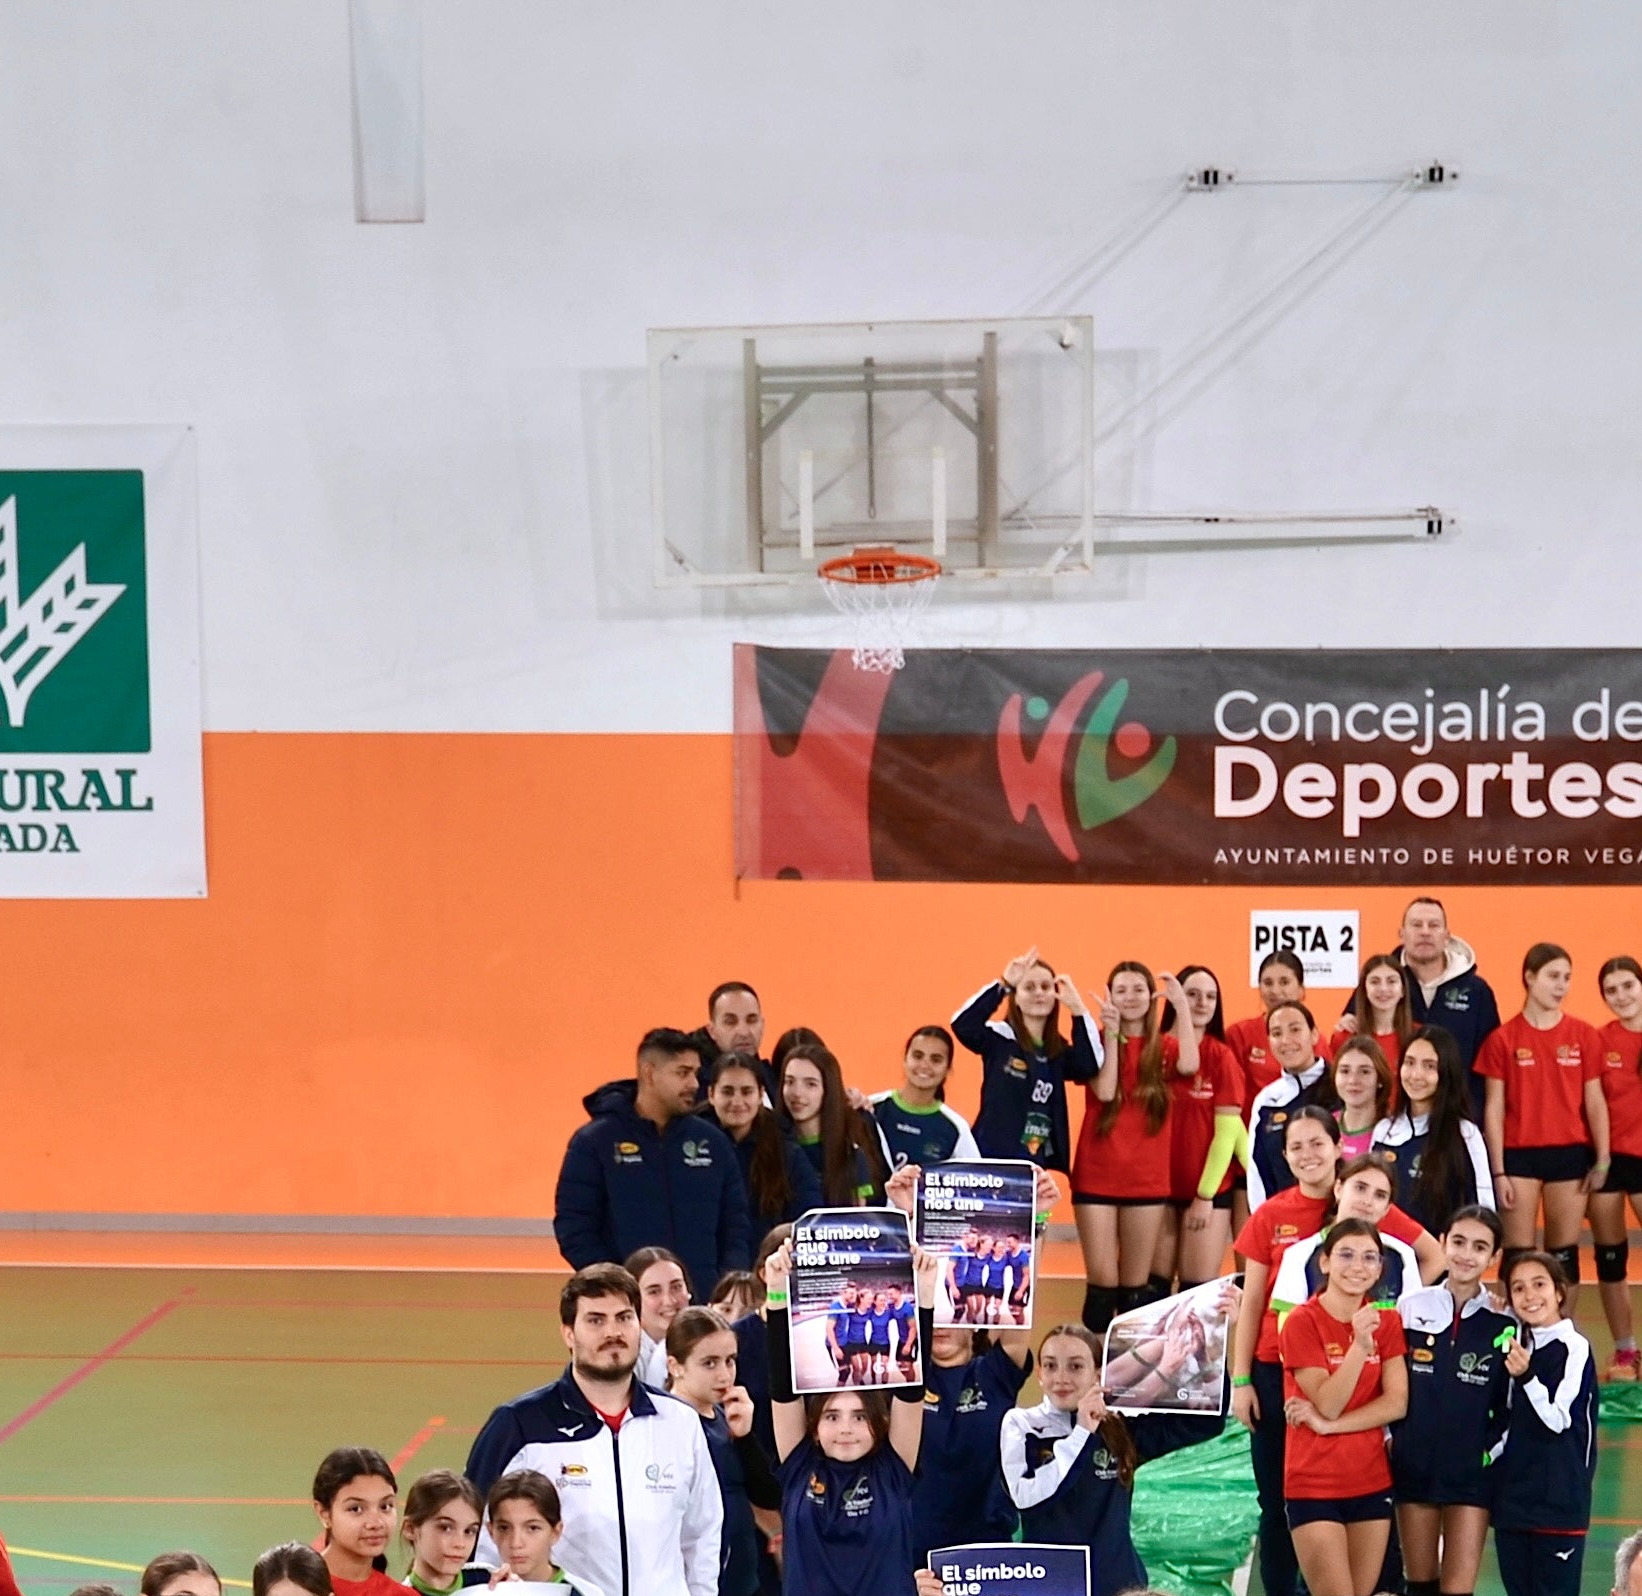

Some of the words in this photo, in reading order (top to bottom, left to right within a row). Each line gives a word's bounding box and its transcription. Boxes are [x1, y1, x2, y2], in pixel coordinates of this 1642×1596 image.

[1213, 683, 1546, 756] Concejalía
[1214, 847, 1411, 865] AYUNTAMIENTO
[1423, 847, 1455, 865] DE
[1468, 844, 1570, 865] HUÉTOR
[1255, 925, 1329, 952] PISTA
[1340, 925, 1354, 951] 2
[925, 1172, 941, 1187] El
[924, 1186, 955, 1201] que
[924, 1197, 953, 1210] nos
[954, 1198, 984, 1211] une
[796, 1226, 812, 1241] El
[796, 1241, 829, 1255] que
[797, 1253, 827, 1267] nos
[829, 1252, 861, 1265] une
[942, 1564, 962, 1582] El
[965, 1562, 1046, 1581] símbolo
